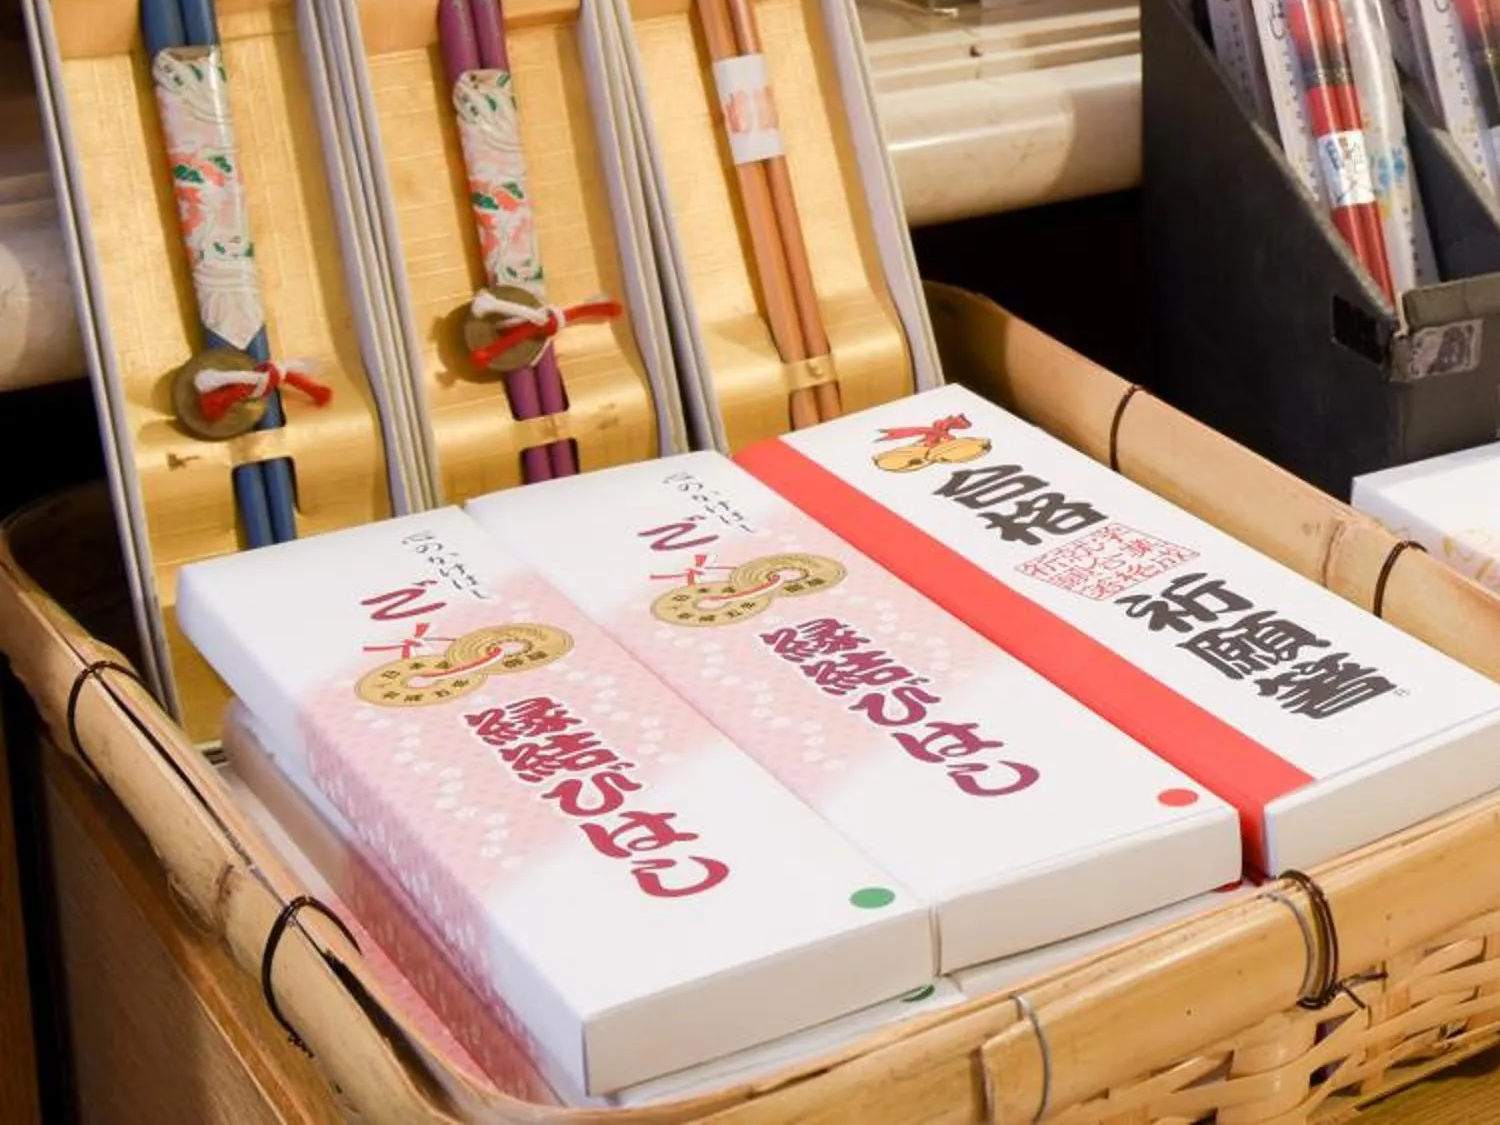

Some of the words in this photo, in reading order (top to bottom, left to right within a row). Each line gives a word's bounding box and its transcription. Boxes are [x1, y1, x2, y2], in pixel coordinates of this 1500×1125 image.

[932, 462, 1111, 547] 合格
[1112, 571, 1398, 721] 祈願箸
[462, 695, 731, 899] 縁結びはし
[758, 617, 1041, 798] 縁結びはし
